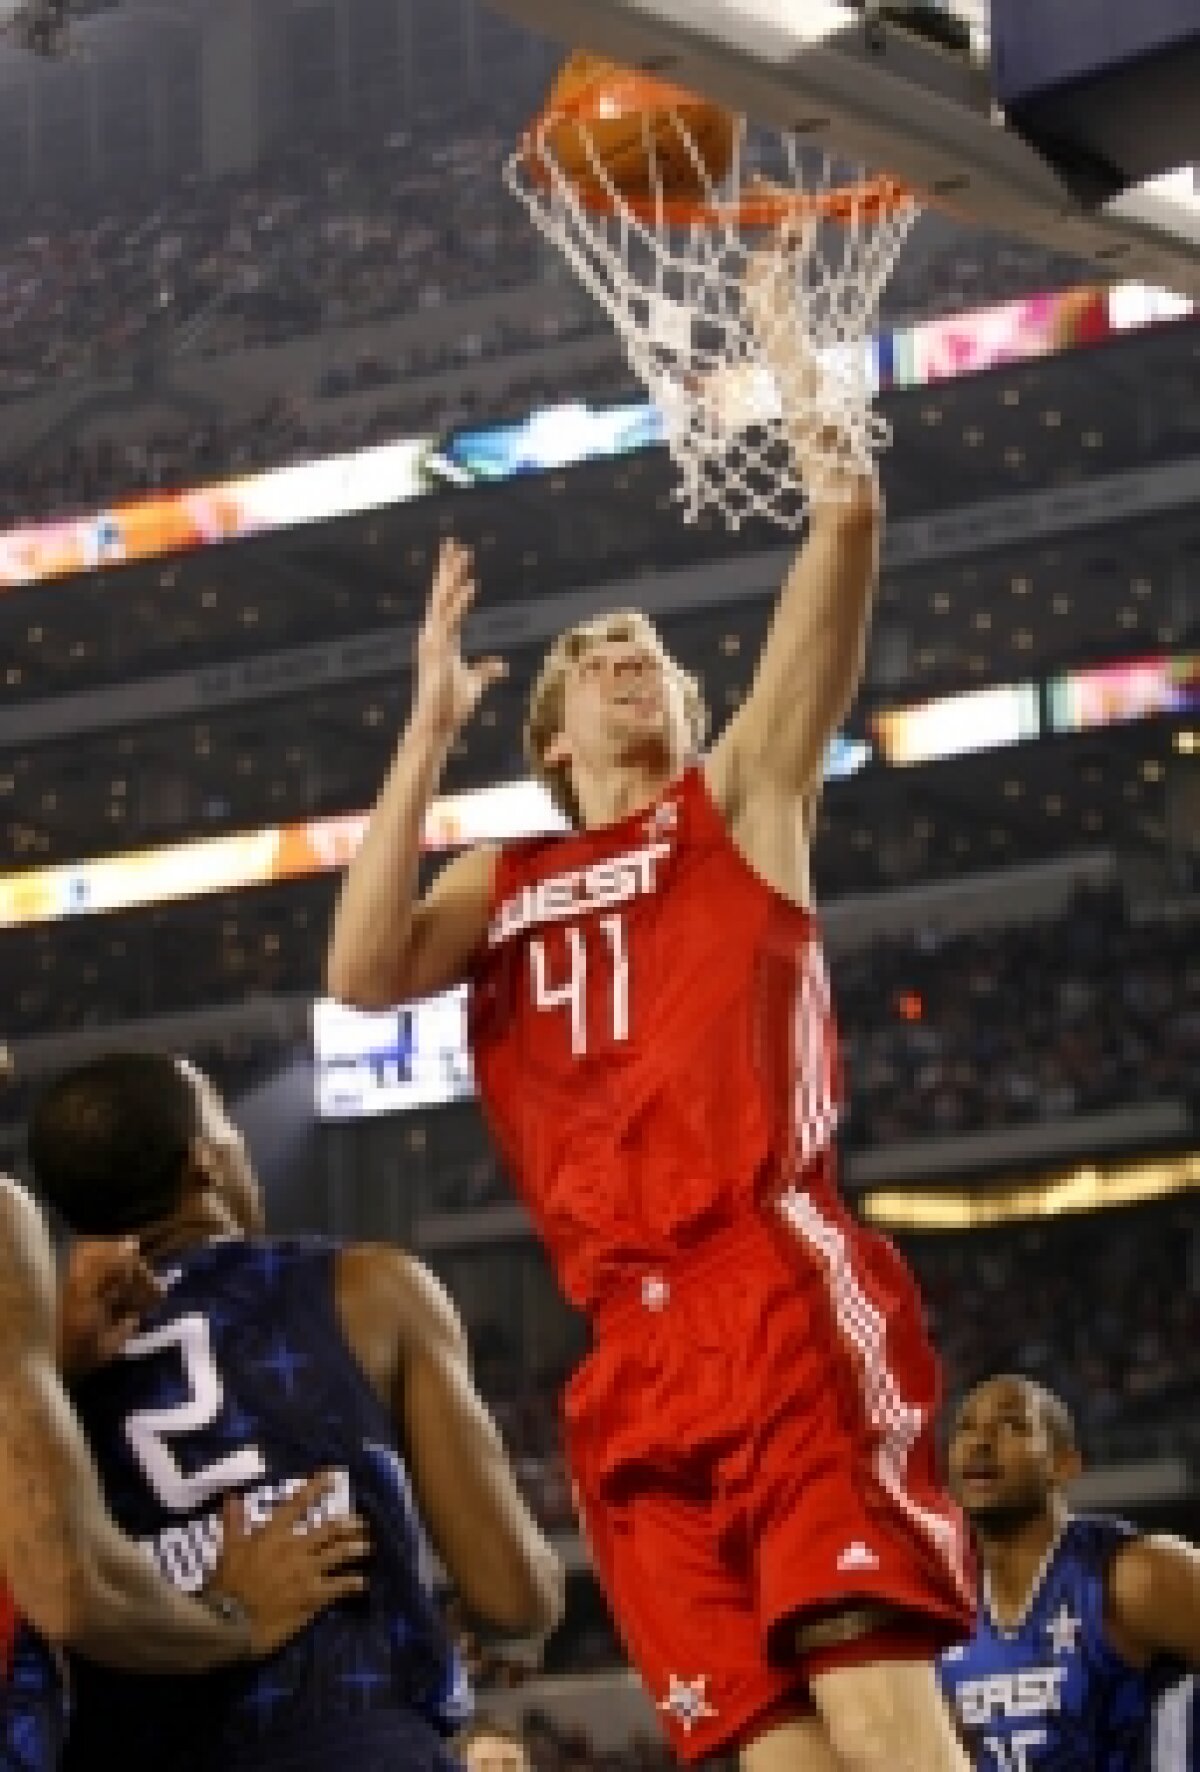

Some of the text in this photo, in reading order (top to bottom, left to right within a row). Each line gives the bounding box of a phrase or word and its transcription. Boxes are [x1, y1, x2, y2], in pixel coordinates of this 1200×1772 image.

[488, 843, 670, 943] WEST
[530, 913, 629, 1055] 41
[122, 1311, 265, 1508] 2
[955, 1666, 1068, 1724] EAST
